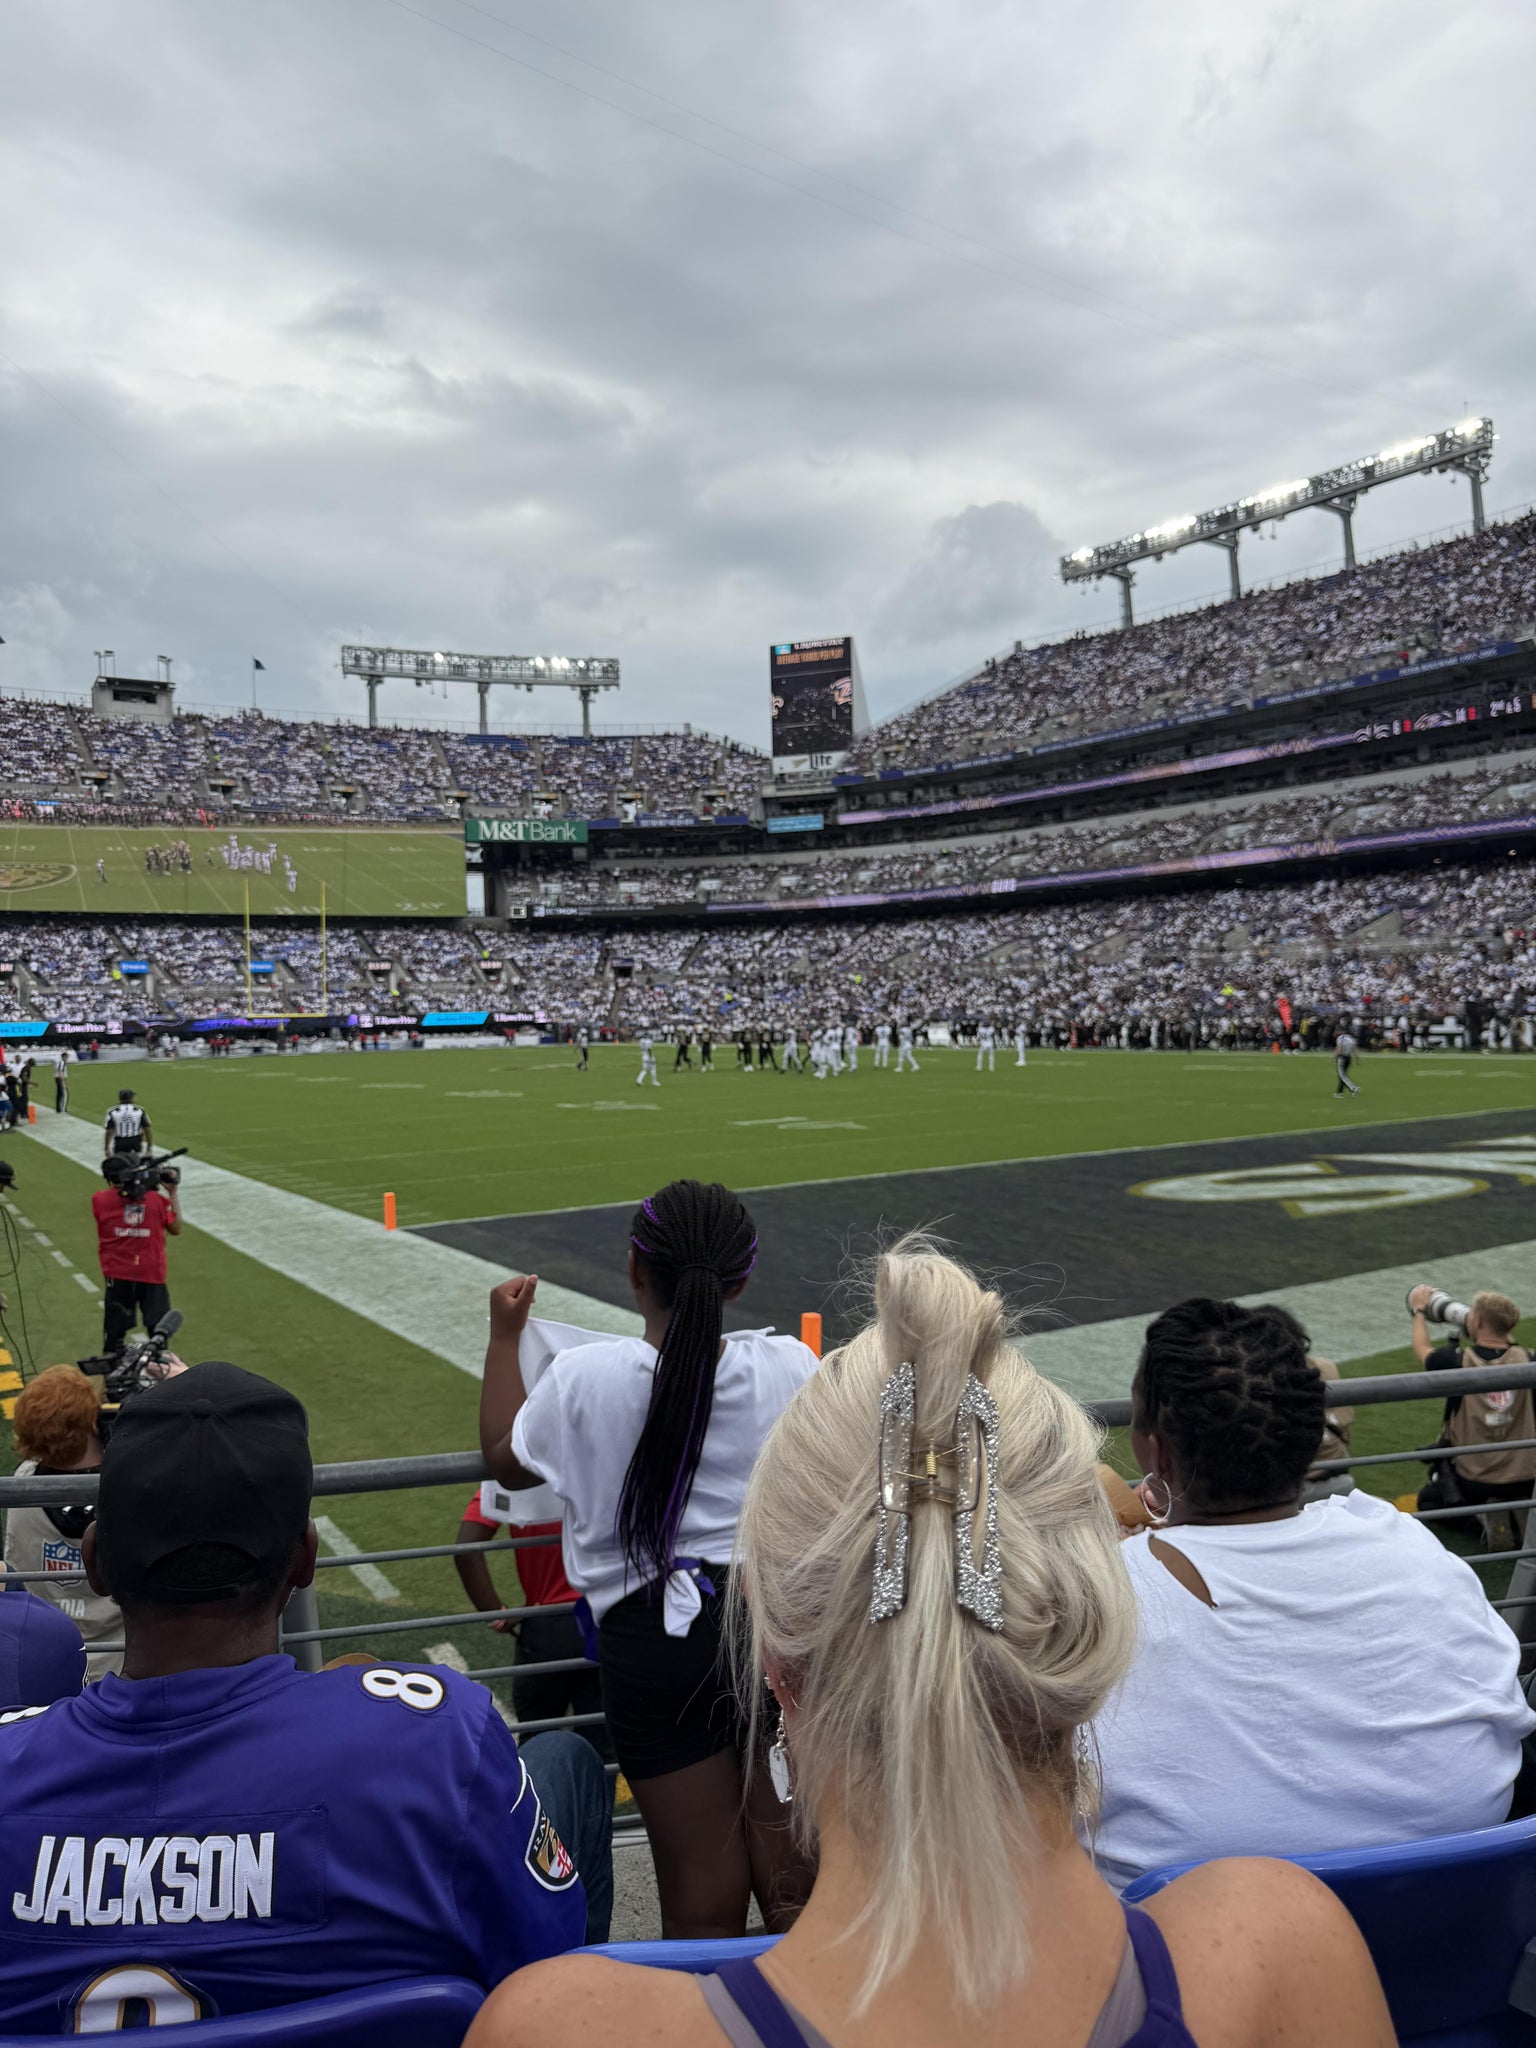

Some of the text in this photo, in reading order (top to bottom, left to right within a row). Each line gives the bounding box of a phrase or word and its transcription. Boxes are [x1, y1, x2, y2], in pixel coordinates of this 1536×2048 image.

[478, 820, 577, 841] M&T Bank
[57, 1599, 86, 1617] DIA
[362, 1668, 444, 1710] 8
[12, 1832, 275, 1927] JACKSON
